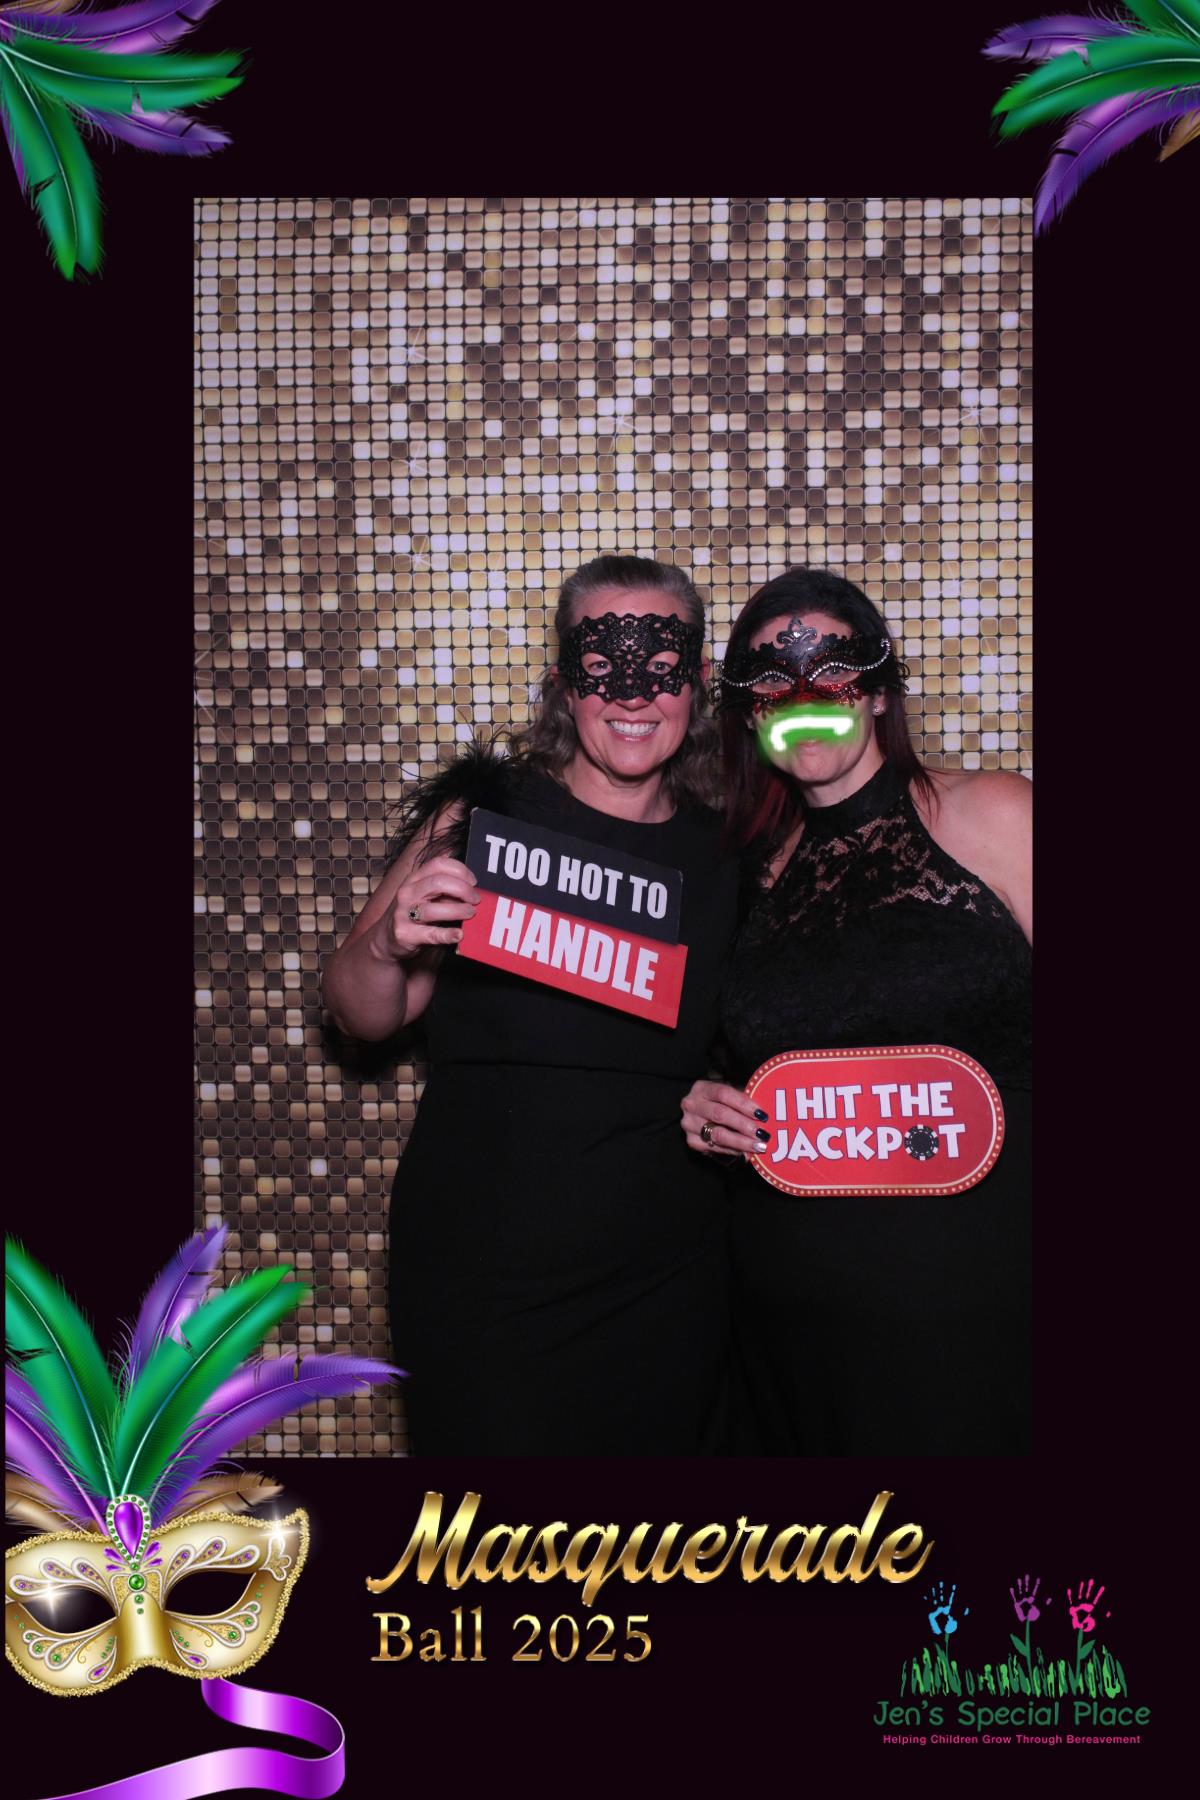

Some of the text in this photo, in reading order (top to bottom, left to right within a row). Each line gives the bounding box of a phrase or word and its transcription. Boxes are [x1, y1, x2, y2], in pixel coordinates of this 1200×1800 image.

[486, 834, 668, 919] TOO HOT TO
[489, 896, 659, 1001] HANDLE
[775, 1081, 954, 1121] I HIT THE
